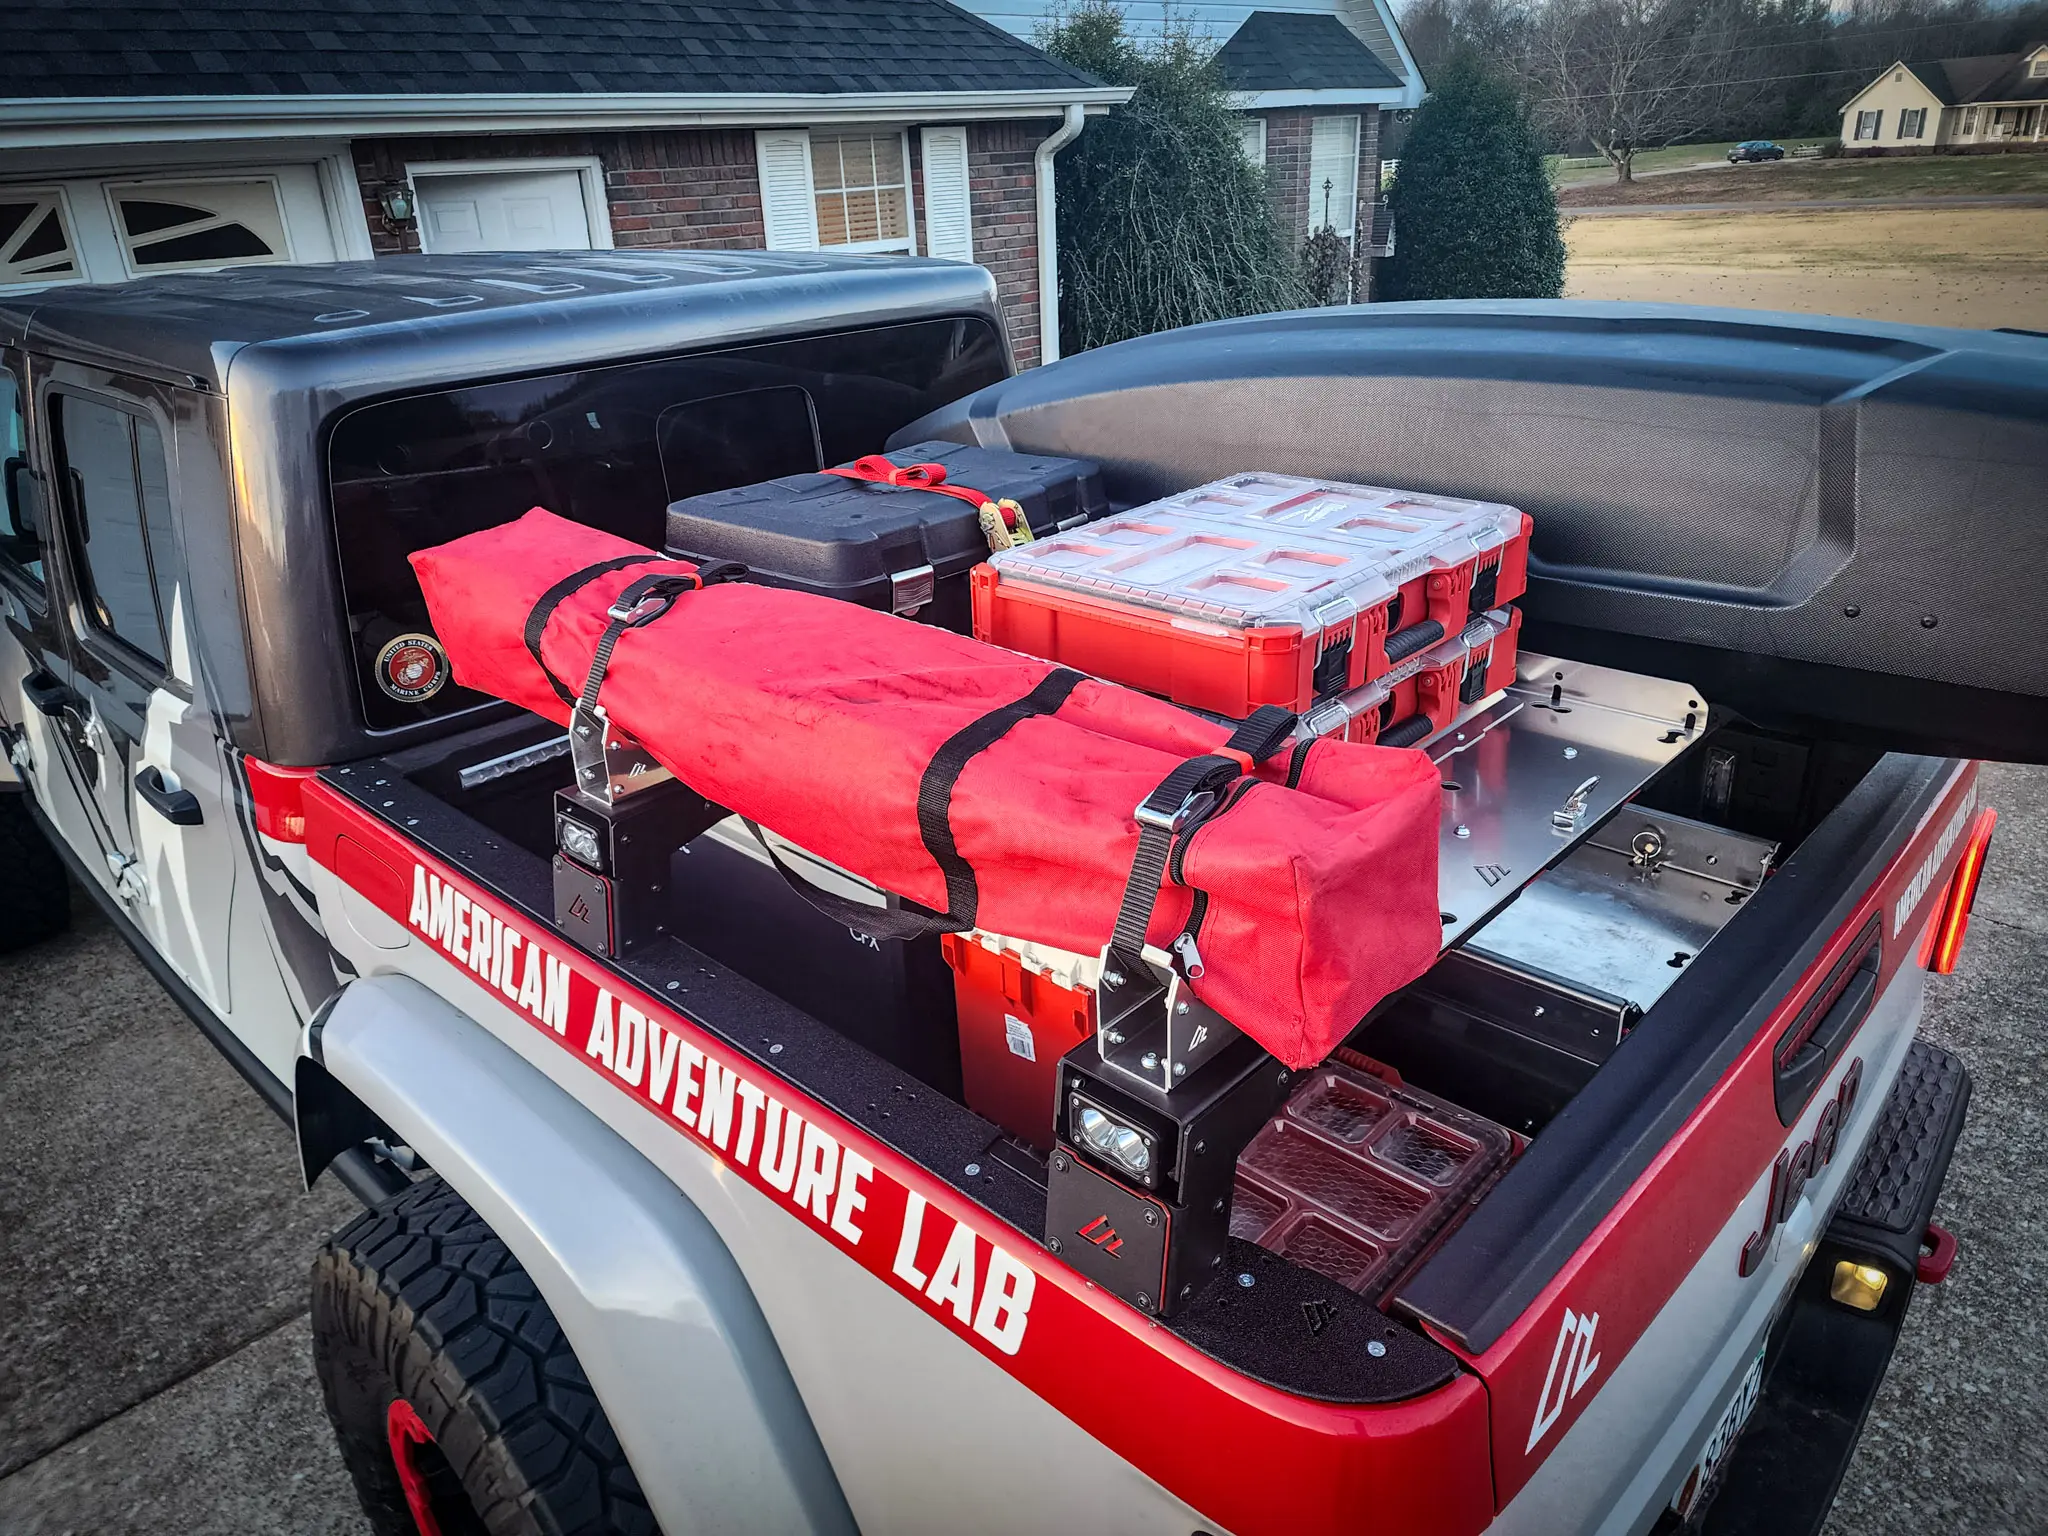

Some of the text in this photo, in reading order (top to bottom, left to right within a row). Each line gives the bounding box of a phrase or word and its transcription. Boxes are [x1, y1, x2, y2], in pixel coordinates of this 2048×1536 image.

[384, 640, 433, 662] UNITED STATES
[390, 671, 441, 696] MARINE CORPS
[409, 864, 1037, 1357] AMERICAN ADVENTURE LAB
[1739, 1056, 1863, 1278] Jeep
